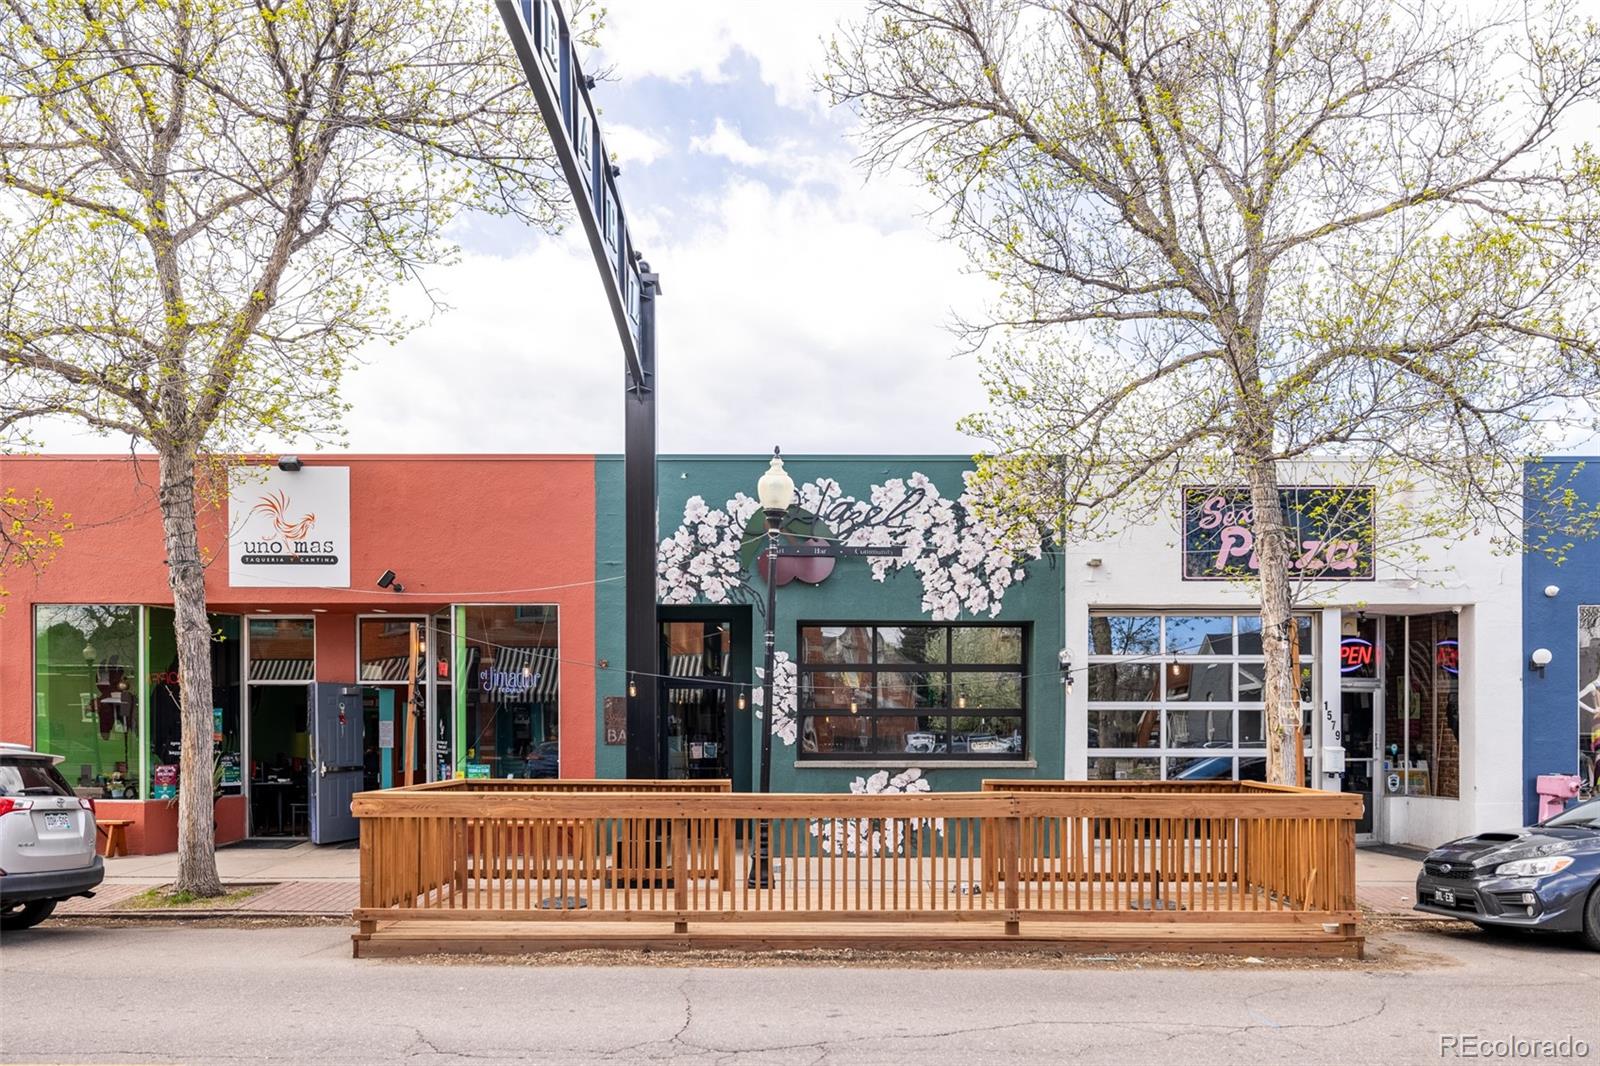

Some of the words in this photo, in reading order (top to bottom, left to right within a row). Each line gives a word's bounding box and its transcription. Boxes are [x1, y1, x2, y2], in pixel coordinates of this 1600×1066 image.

[1199, 496, 1254, 529] Sex
[244, 541, 283, 554] uno
[294, 541, 334, 554] mas
[1215, 526, 1360, 571] Pza
[1341, 646, 1373, 665] PEN
[1323, 700, 1341, 741] 1579
[607, 728, 627, 743] BA
